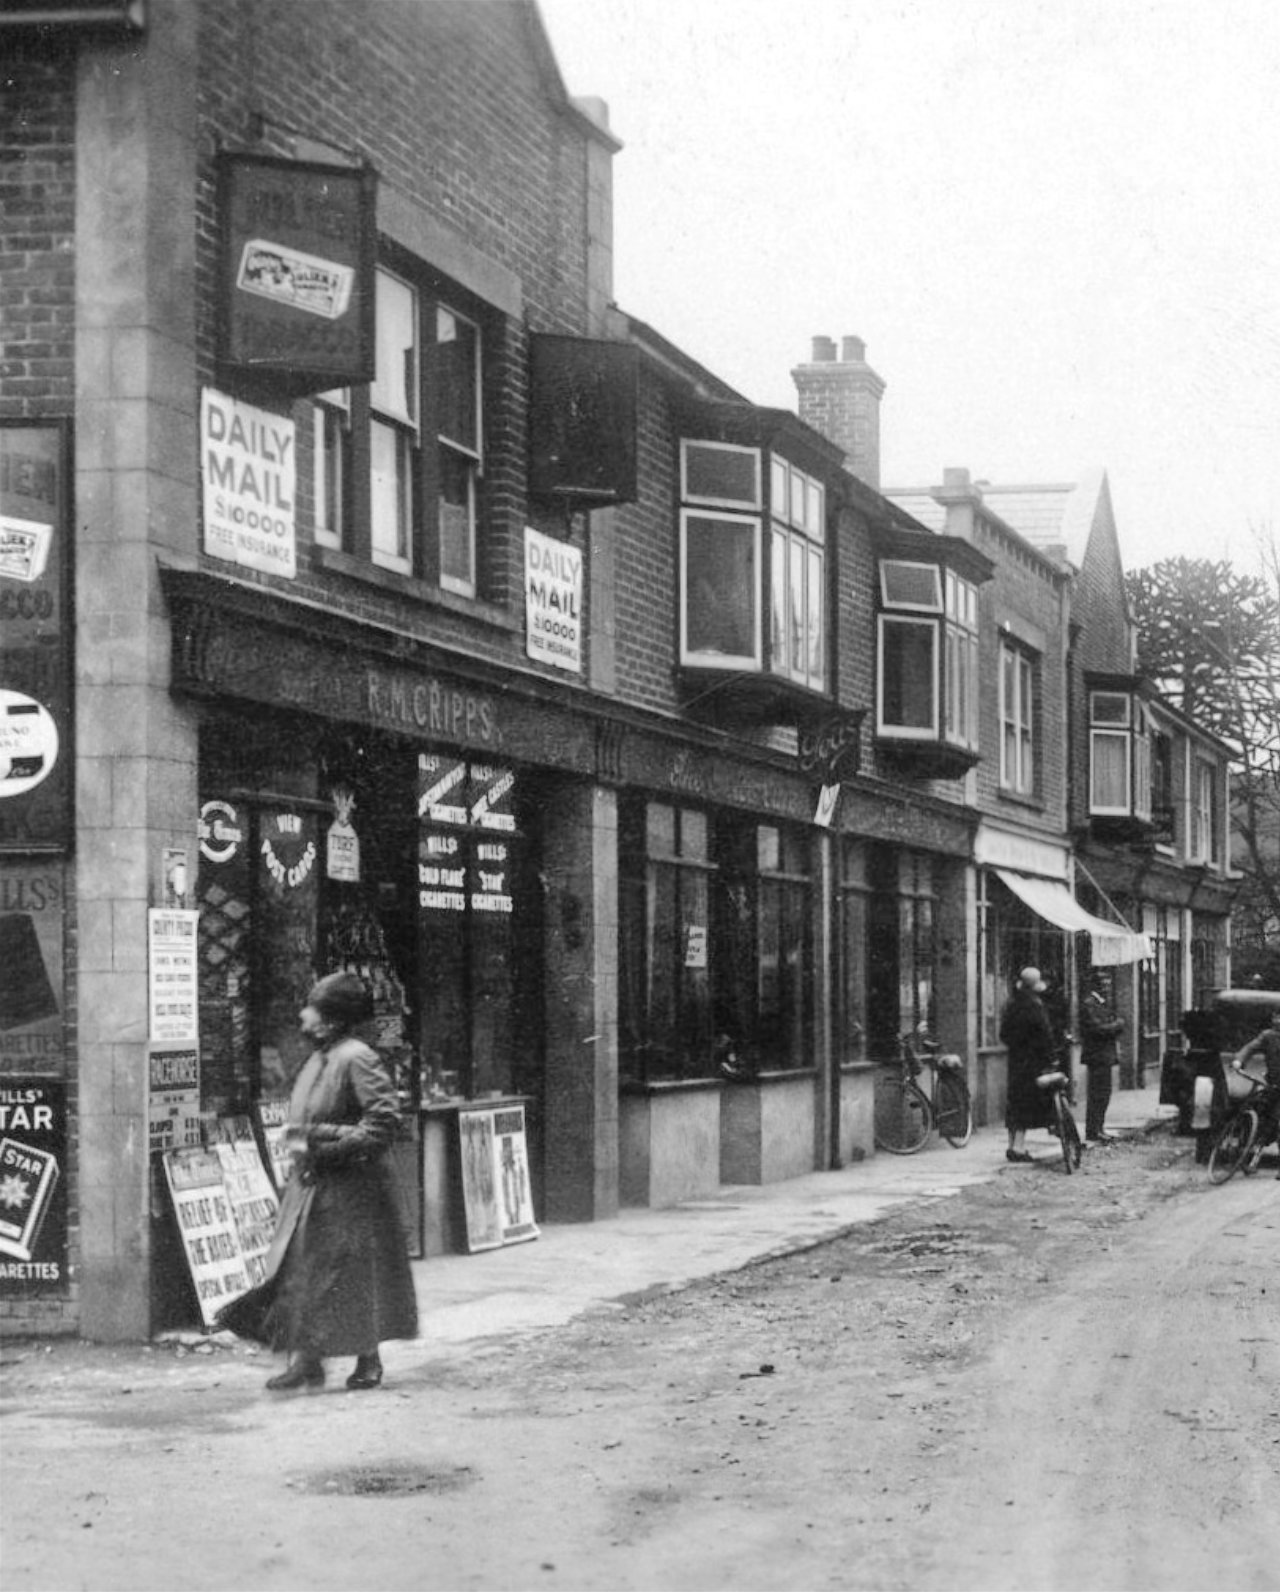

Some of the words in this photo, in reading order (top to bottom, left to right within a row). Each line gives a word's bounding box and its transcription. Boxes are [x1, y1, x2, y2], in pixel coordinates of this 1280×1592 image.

[207, 403, 291, 466] DAILY
[208, 450, 291, 513] MAIL
[209, 523, 235, 547] FREE
[529, 541, 580, 587] DAILY
[530, 577, 577, 620] MAIL
[276, 813, 302, 834] VIEW
[0, 1089, 44, 1104] ILLS'
[4, 1148, 43, 1176] STAR
